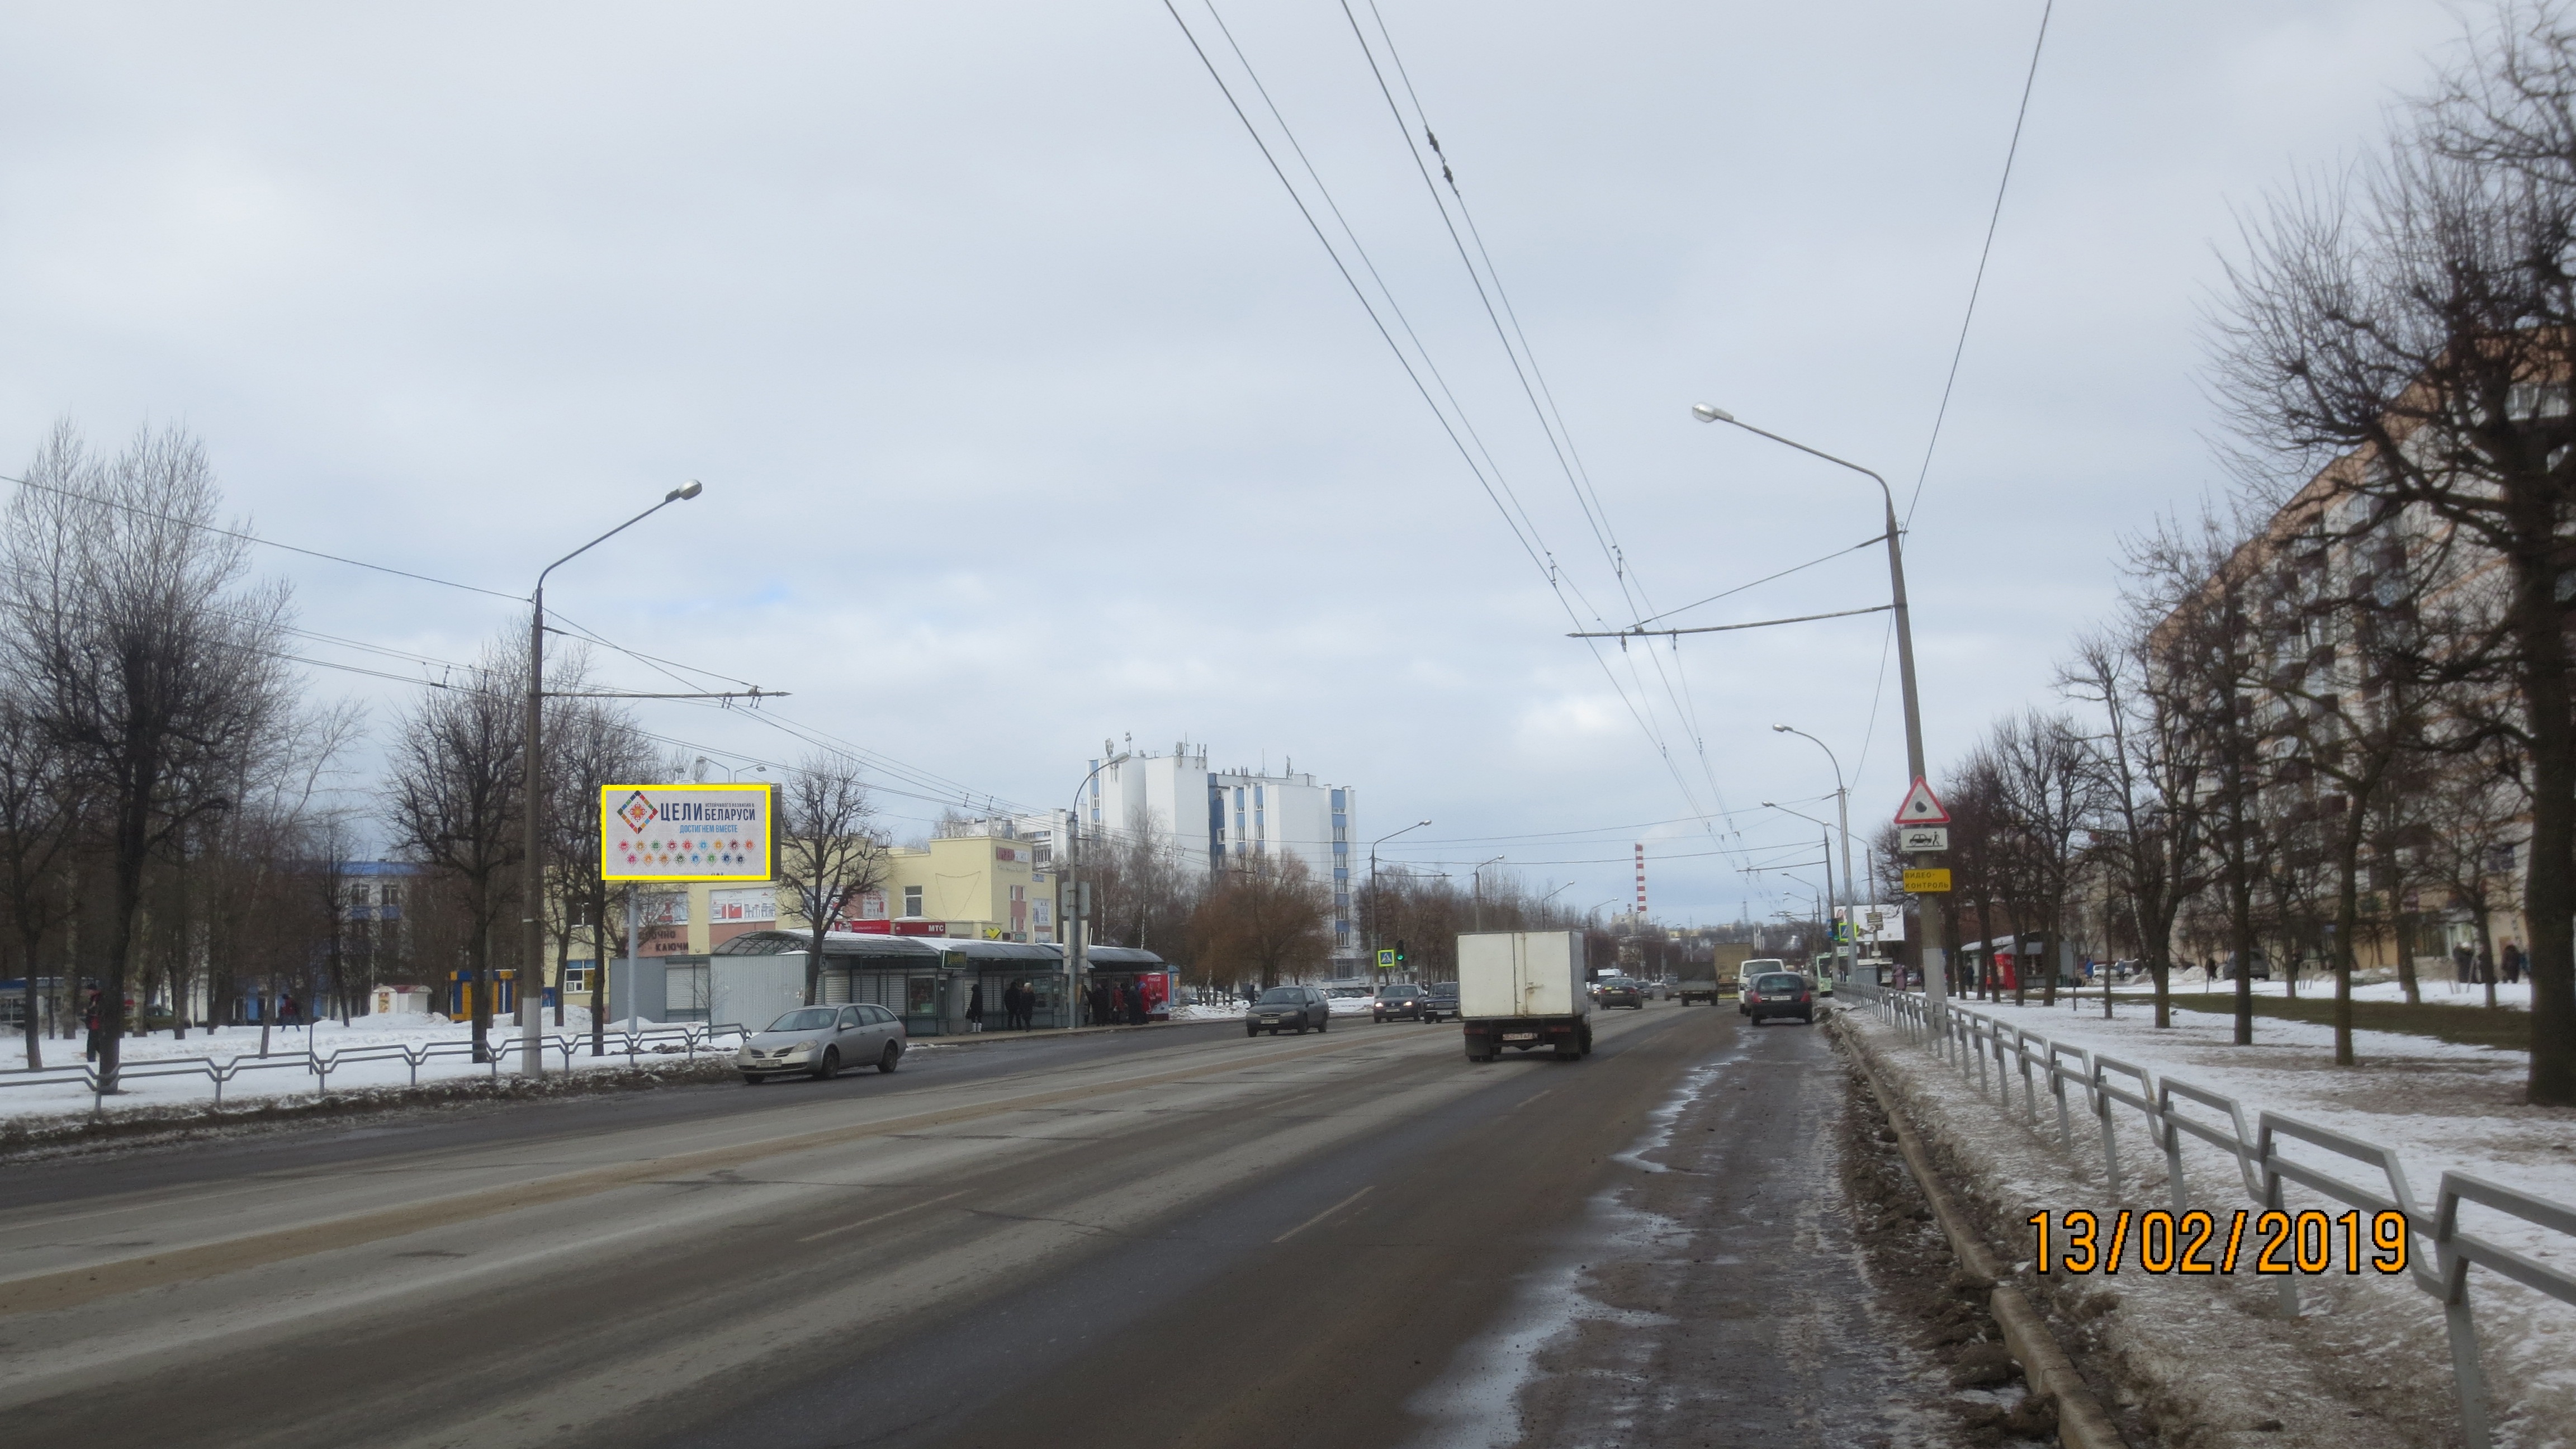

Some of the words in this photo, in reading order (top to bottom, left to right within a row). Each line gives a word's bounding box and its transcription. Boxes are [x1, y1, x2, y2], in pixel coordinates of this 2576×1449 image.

[660, 803, 703, 821] ЦЕЛИ
[704, 808, 755, 821] БЕЛАРУСИ
[679, 825, 714, 834] ДОСТИГНЕМ
[716, 825, 738, 833] ВМЕСТЕ
